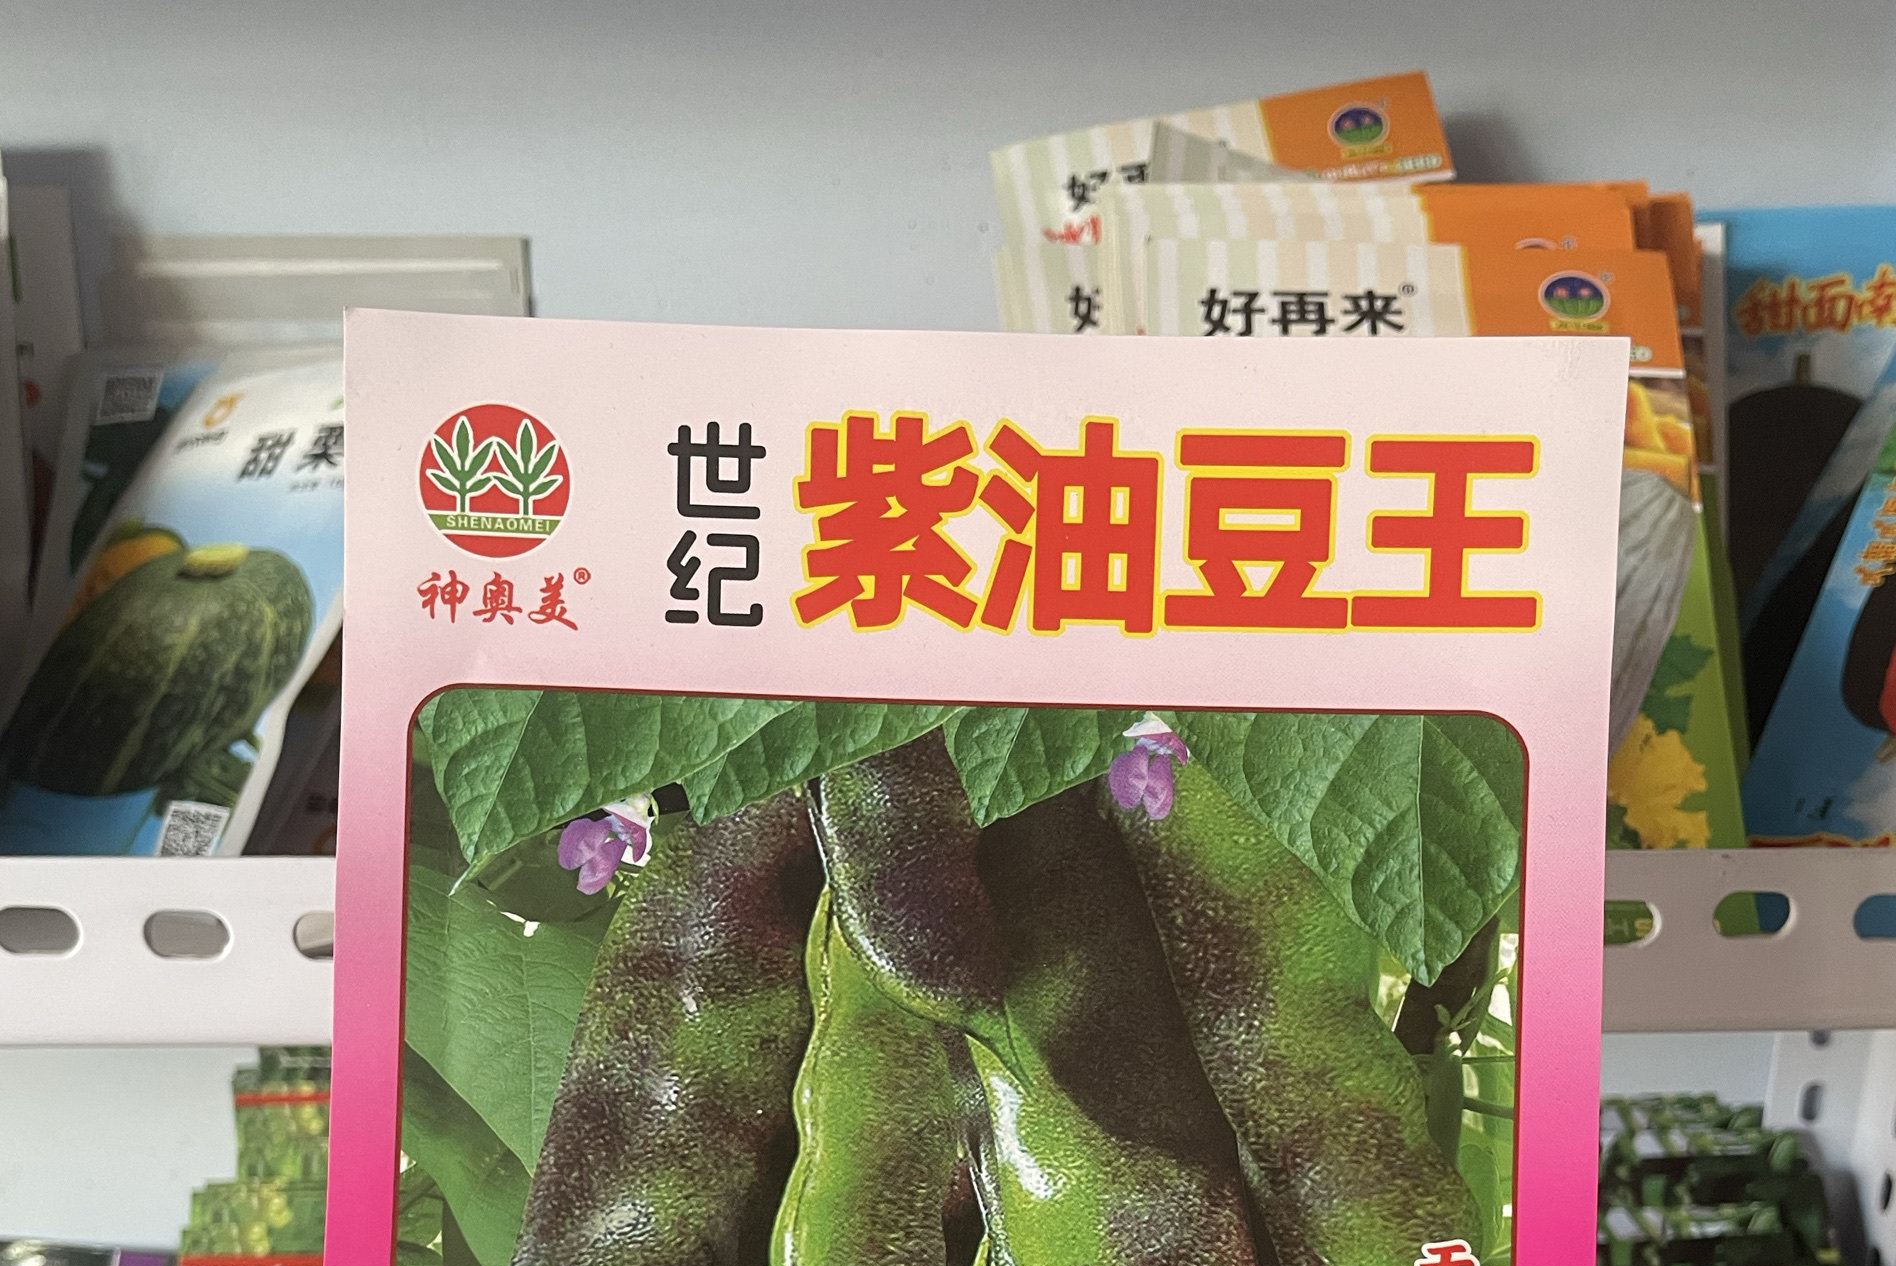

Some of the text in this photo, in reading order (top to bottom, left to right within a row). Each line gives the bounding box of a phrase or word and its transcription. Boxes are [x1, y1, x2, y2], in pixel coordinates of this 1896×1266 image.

[1201, 287, 1405, 336] 好再来
[445, 514, 551, 534] SHENAOMEI
[665, 421, 767, 627] 世纪
[792, 410, 1543, 638] 紫油豆王
[417, 570, 579, 631] 神奥美
